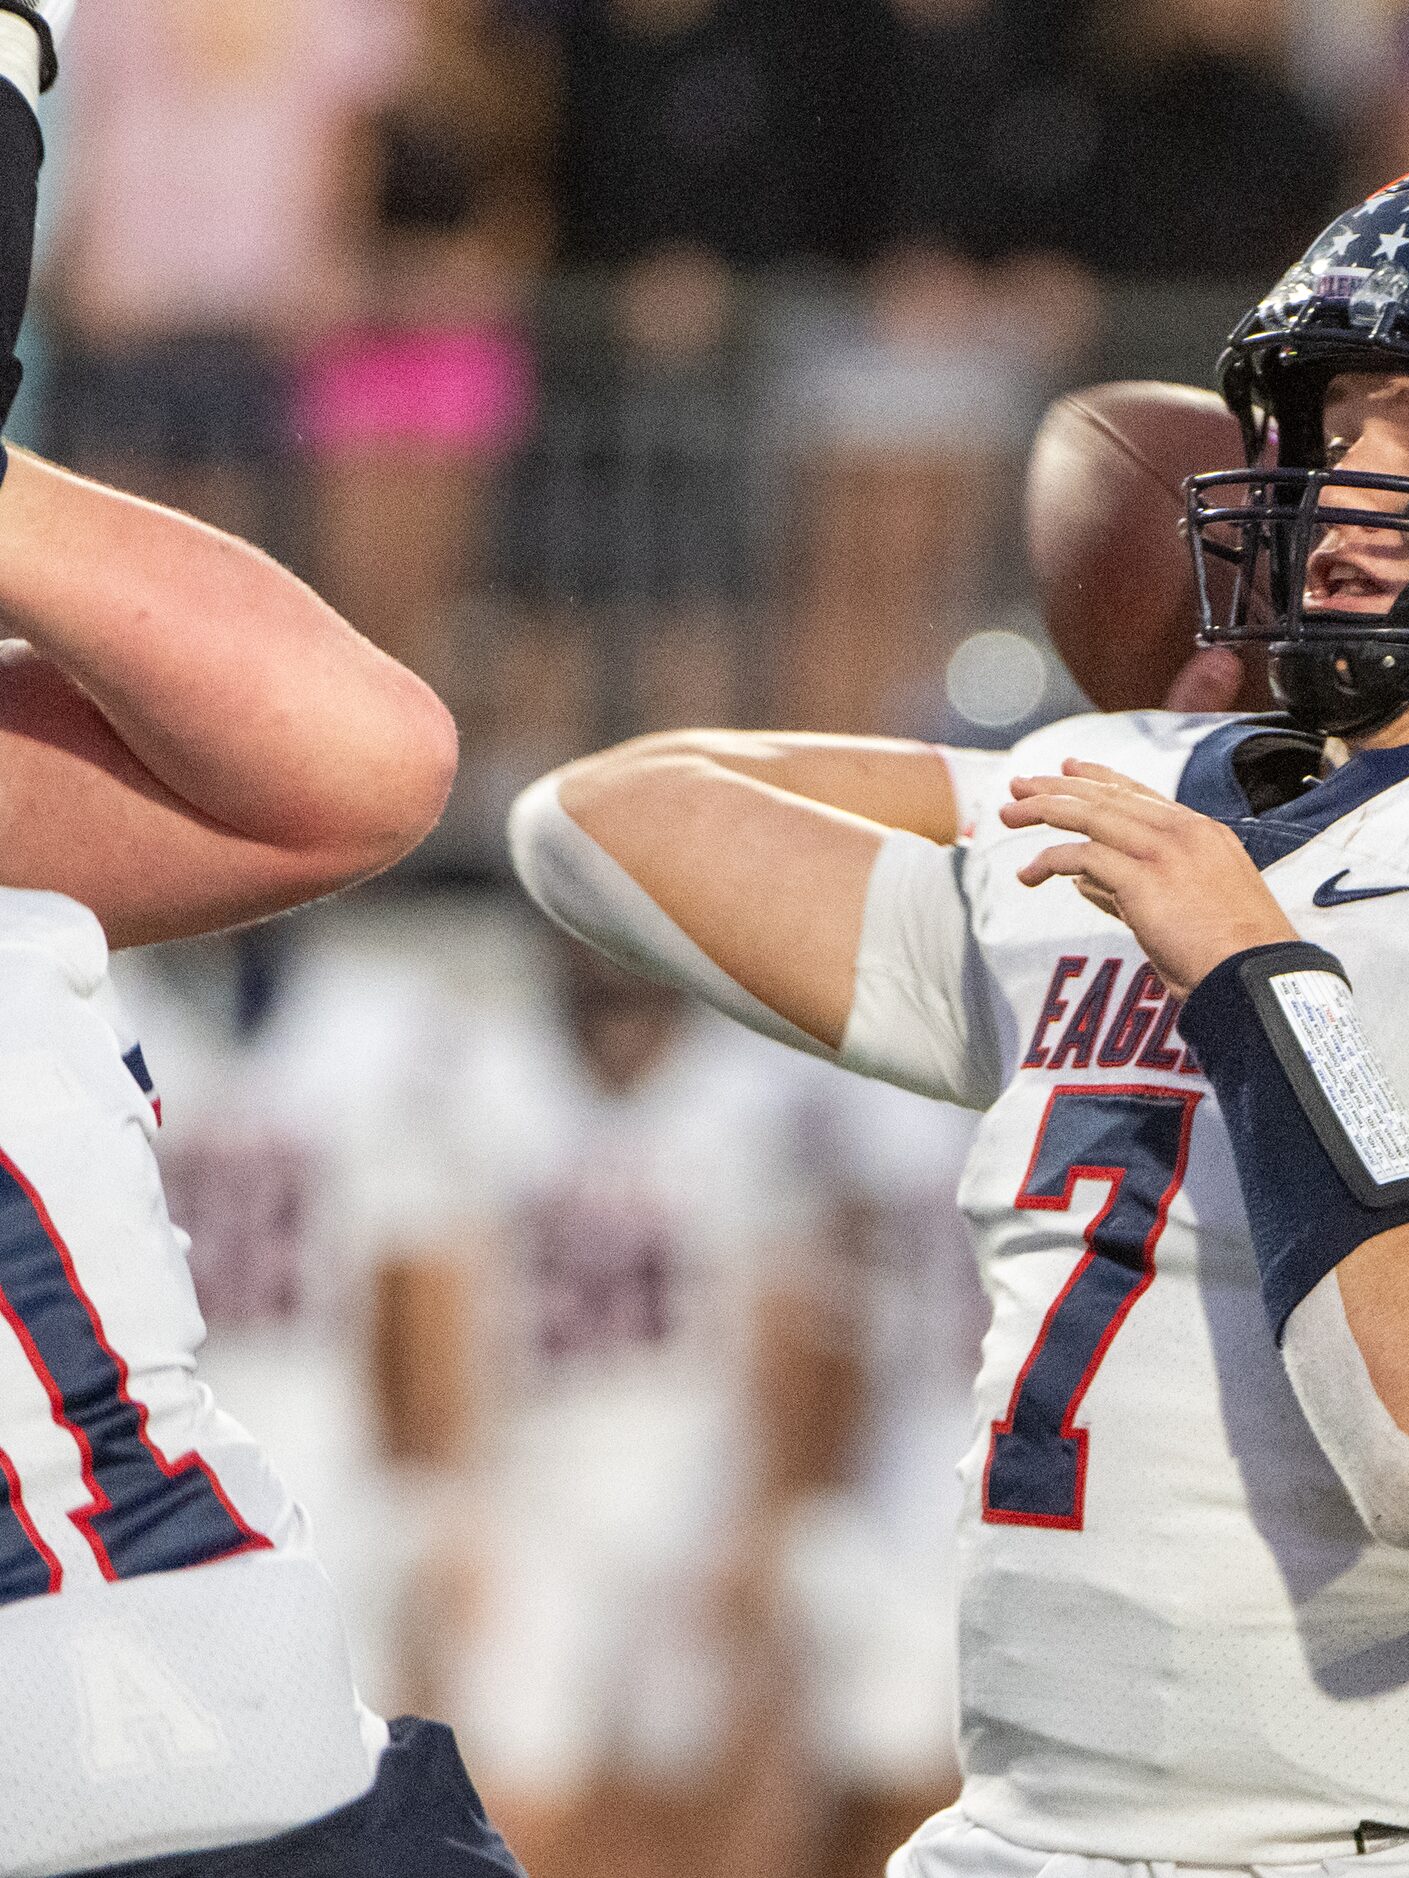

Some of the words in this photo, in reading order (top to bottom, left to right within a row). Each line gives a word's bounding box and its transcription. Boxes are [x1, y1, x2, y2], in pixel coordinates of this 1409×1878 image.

[1021, 955, 1203, 1076] EAGL
[981, 1085, 1204, 1531] 7
[70, 1624, 223, 1777] A
